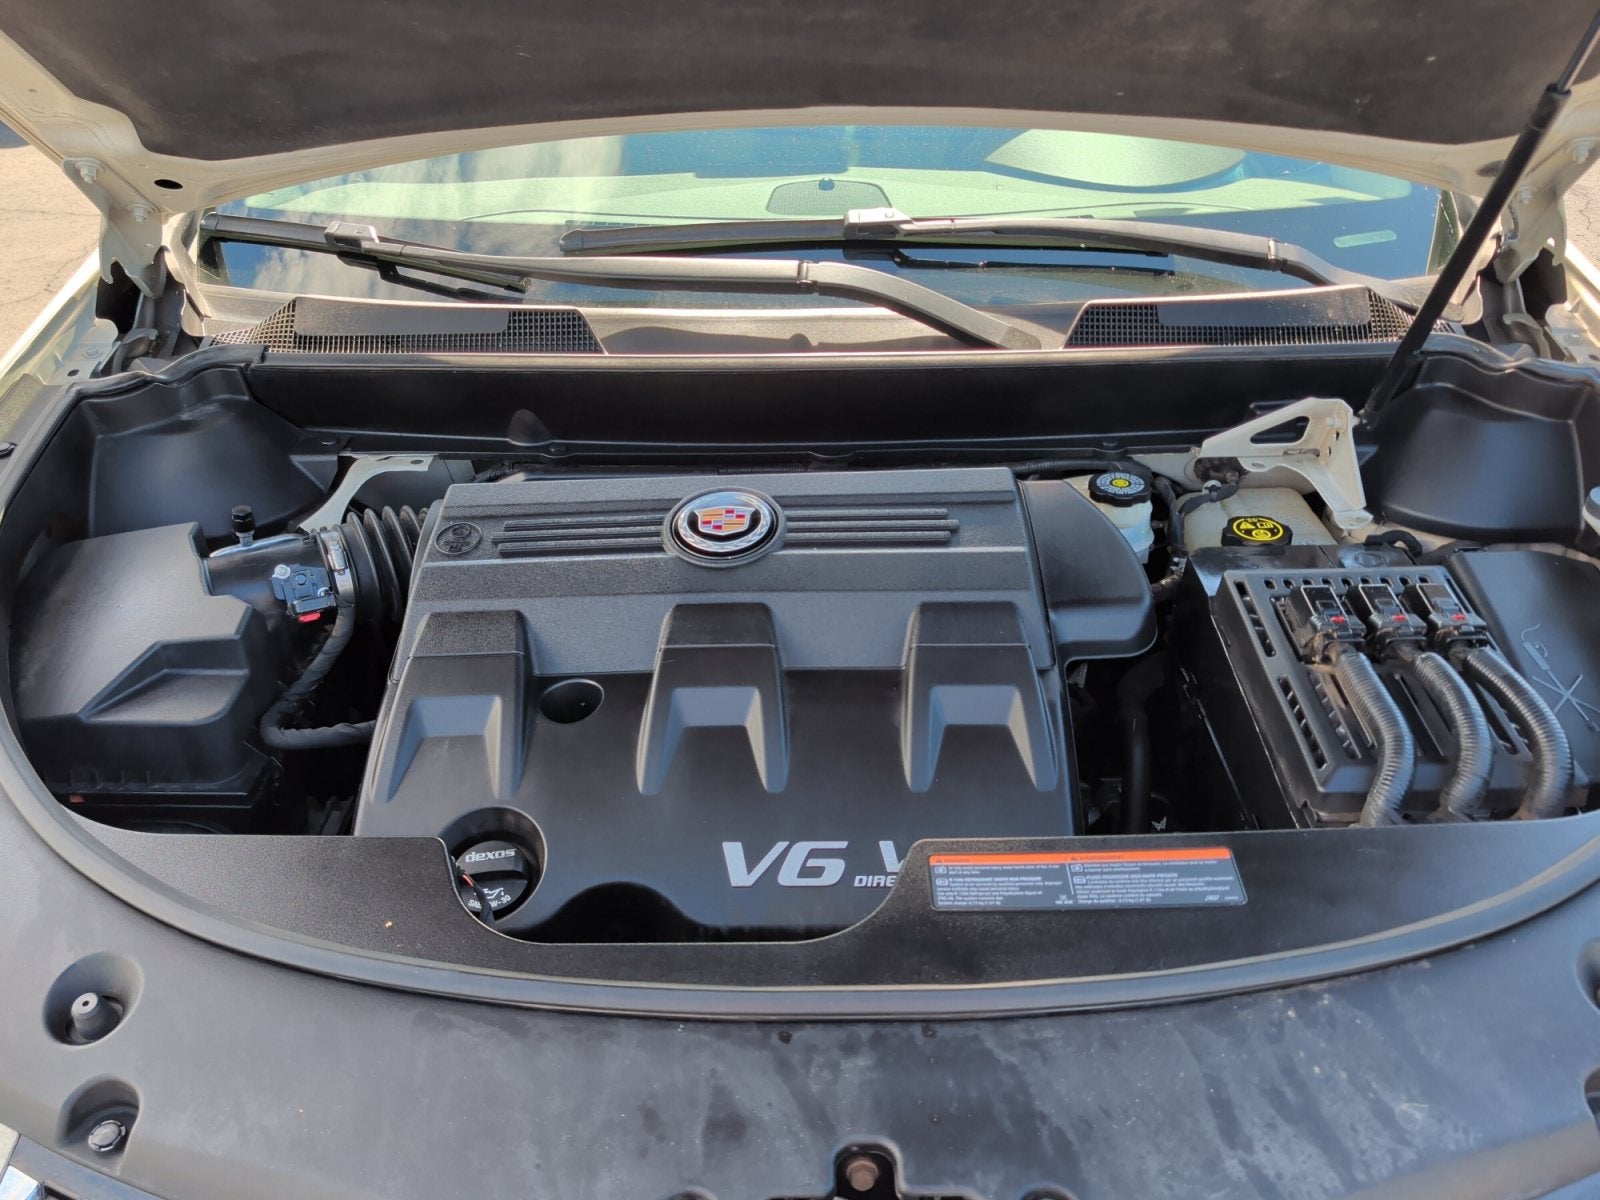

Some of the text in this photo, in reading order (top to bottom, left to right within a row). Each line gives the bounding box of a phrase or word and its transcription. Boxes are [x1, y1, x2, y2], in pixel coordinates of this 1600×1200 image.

[465, 849, 517, 862] dexos
[722, 840, 905, 887] V6 V
[854, 875, 897, 887] DIRE
[488, 894, 512, 908] W-30
